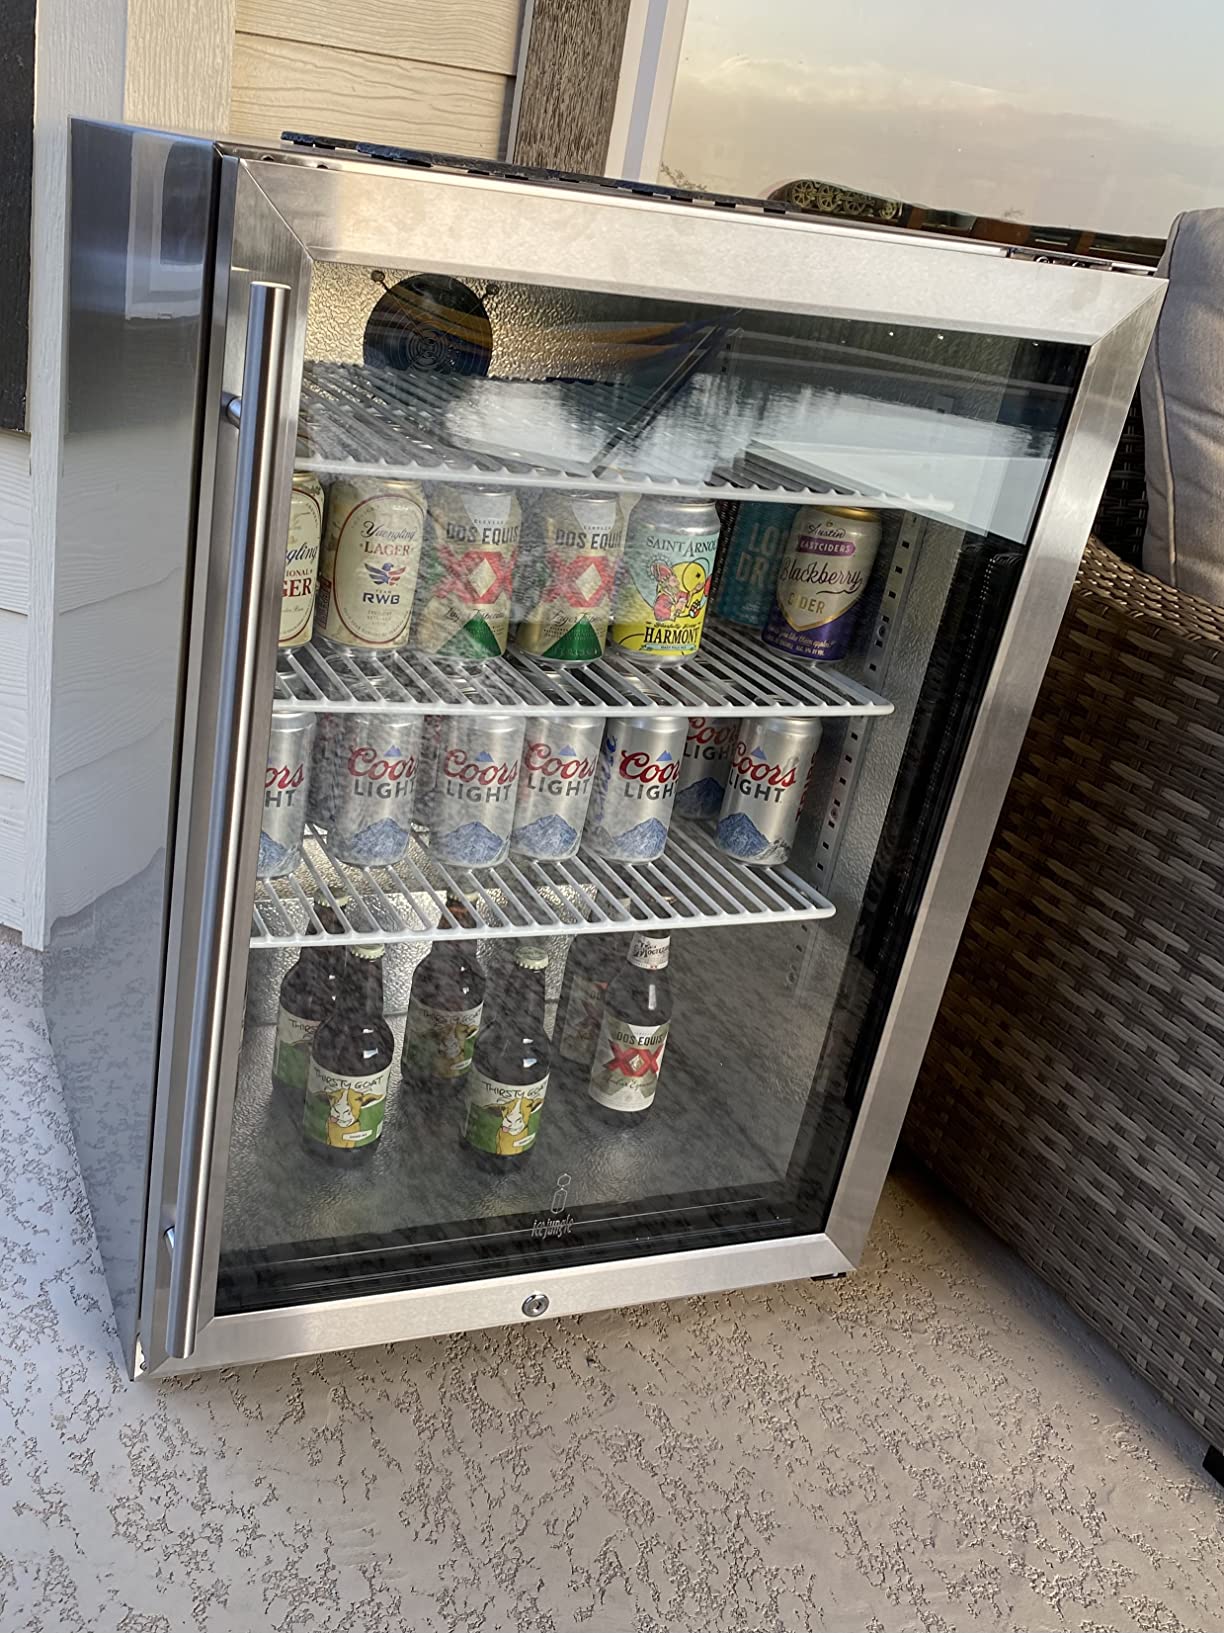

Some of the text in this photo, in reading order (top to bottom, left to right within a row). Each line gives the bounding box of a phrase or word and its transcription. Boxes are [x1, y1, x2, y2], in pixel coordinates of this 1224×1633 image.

[360, 520, 417, 542] Yuengling
[446, 522, 519, 545] DOS EQUIS
[556, 529, 587, 549] DOS
[748, 522, 780, 557] LO
[808, 523, 846, 539] Austin
[286, 541, 319, 565] gling
[363, 541, 410, 556] LAGER
[646, 535, 717, 558] SAINT ARNO
[736, 551, 769, 590] DR
[780, 559, 863, 593] Blackberry
[281, 578, 312, 598] GER
[362, 592, 400, 604] RWB
[788, 592, 825, 614] CIDER
[644, 627, 699, 644] HARMON
[443, 746, 519, 786] Coors
[524, 741, 598, 779] Coors
[619, 750, 680, 784] Coor
[265, 763, 304, 790] ors
[528, 772, 590, 797] LIGHT
[729, 768, 786, 803] LIGHT
[446, 779, 512, 803] LIGHT
[624, 782, 678, 801] LIGH
[617, 1031, 664, 1047] DOS EQUIS
[315, 1066, 384, 1090] THIRSTY GOAT
[482, 1080, 525, 1099] THIRSTY
